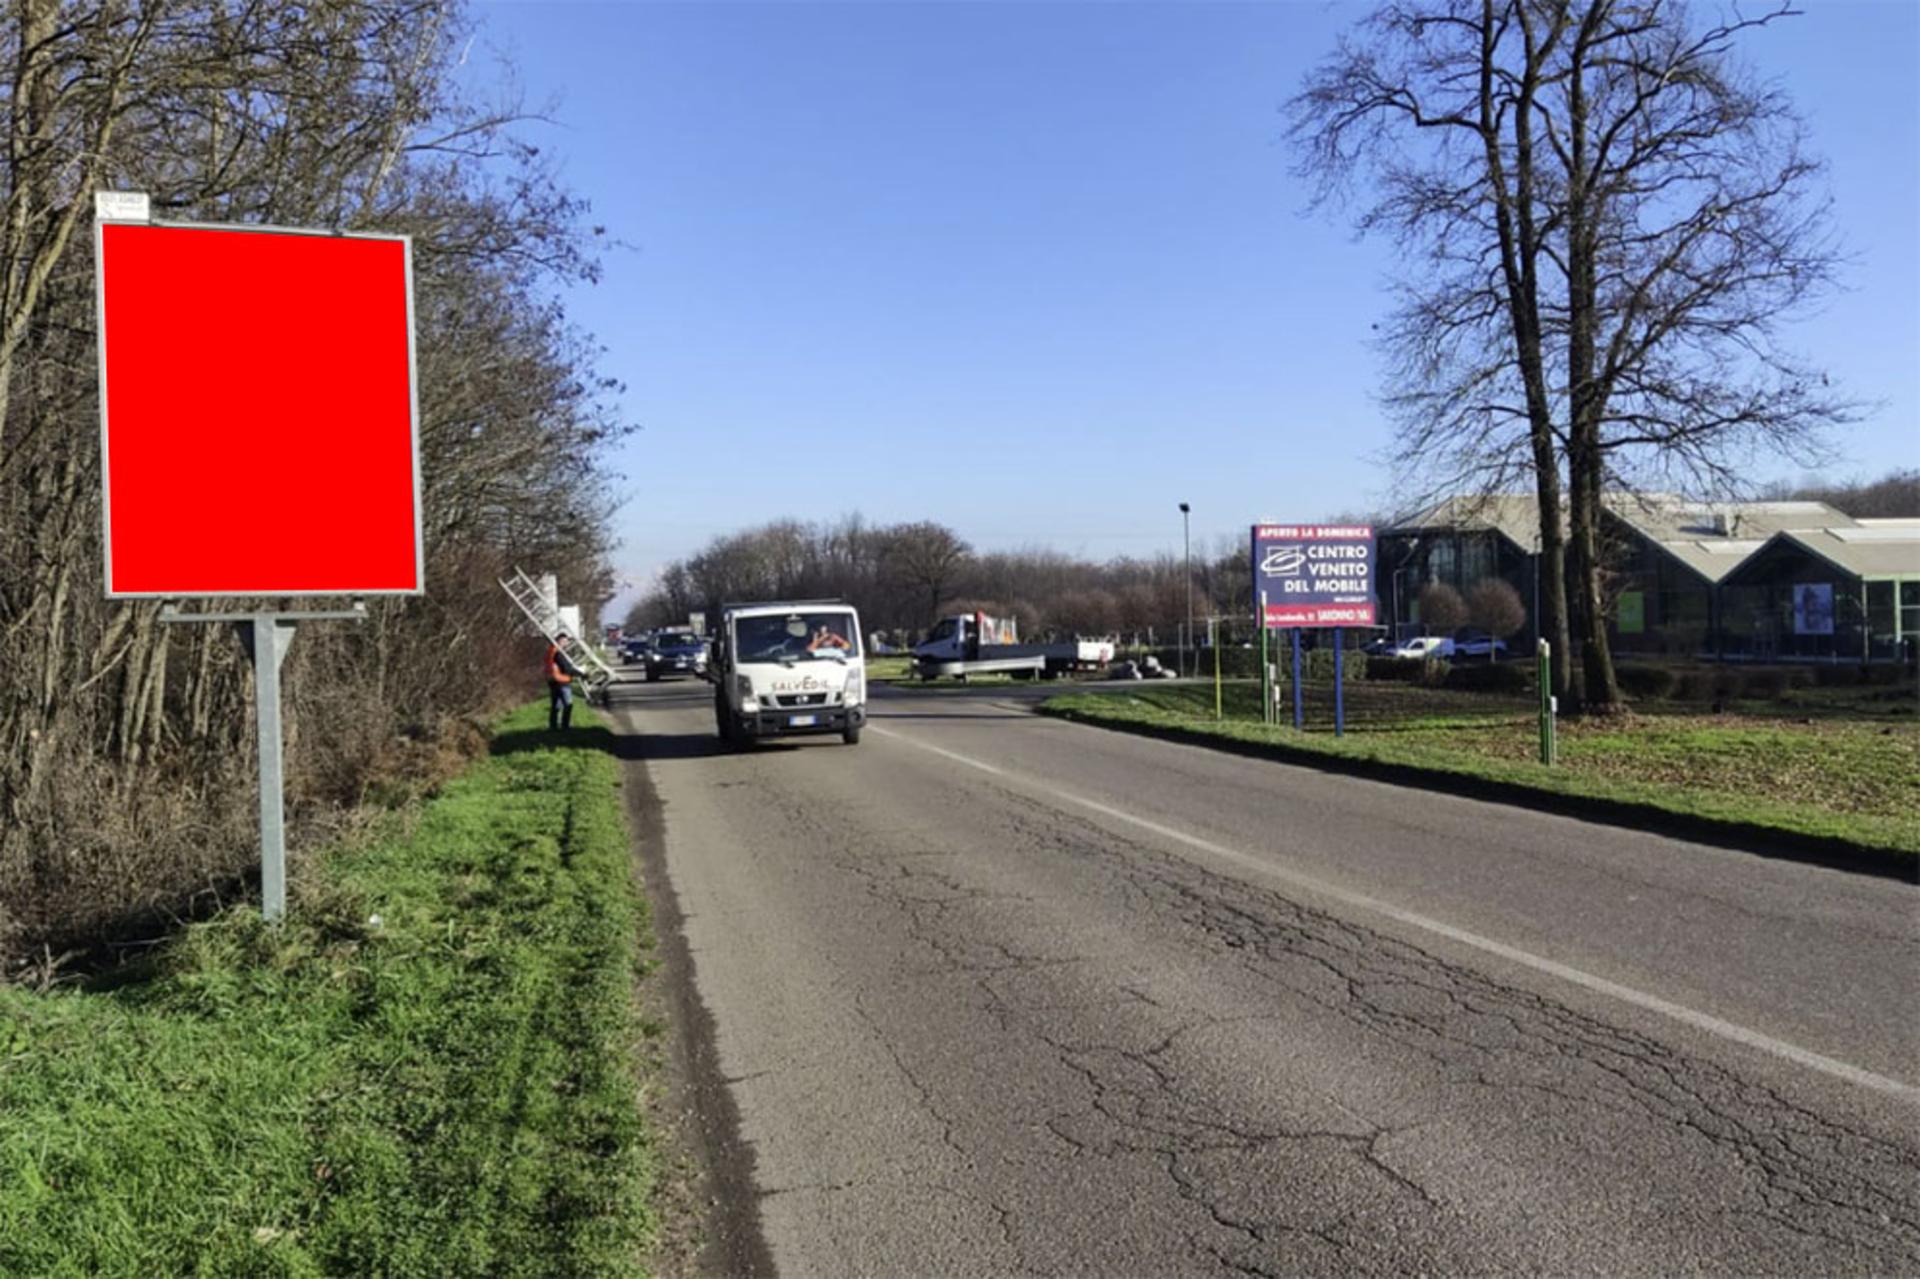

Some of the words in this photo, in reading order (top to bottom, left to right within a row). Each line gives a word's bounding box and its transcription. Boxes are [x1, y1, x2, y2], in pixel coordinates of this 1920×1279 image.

[1260, 527, 1299, 538] APERTO
[1302, 527, 1314, 537] LA
[1317, 527, 1370, 537] DOMENICA
[1307, 545, 1368, 559] CENTRO
[1308, 562, 1368, 576] VENETO
[1284, 579, 1310, 593] DEL
[1314, 579, 1368, 592] MOBILE
